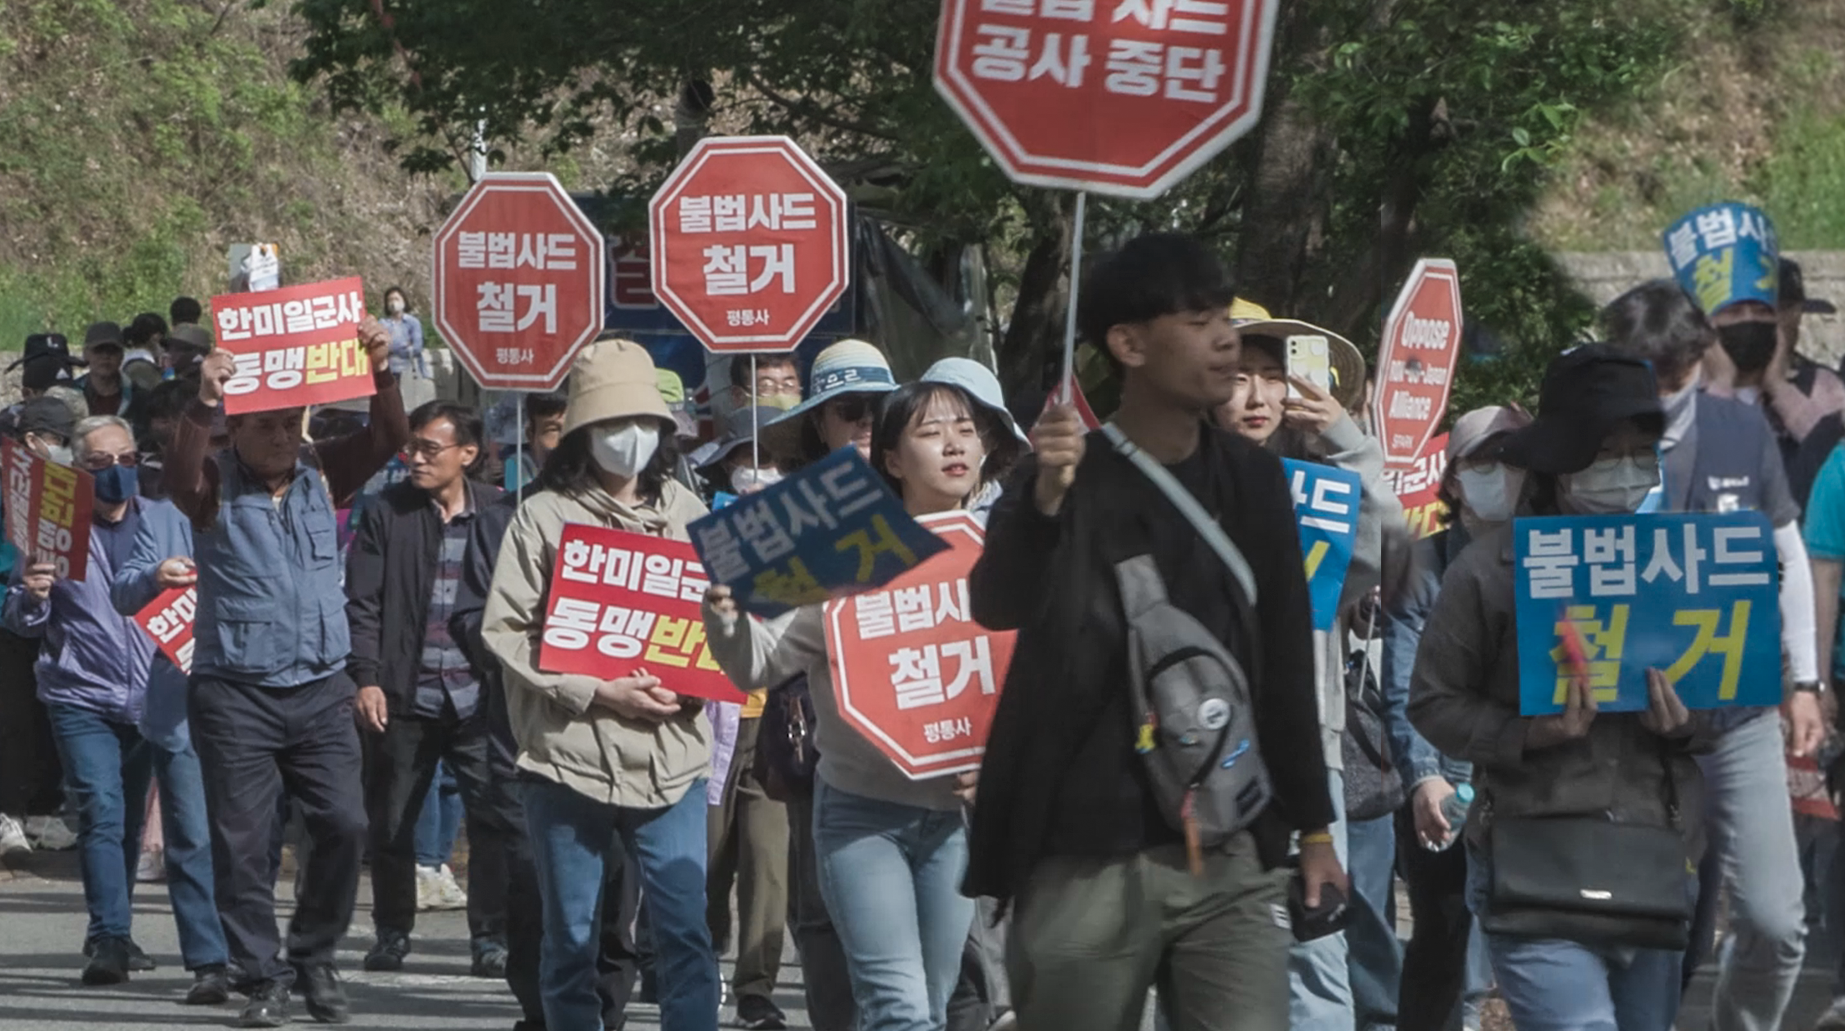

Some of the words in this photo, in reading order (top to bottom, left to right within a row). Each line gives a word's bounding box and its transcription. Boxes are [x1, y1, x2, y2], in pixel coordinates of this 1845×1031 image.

[971, 23, 1092, 88] 공사
[1104, 38, 1226, 103] 중단
[678, 193, 817, 233] 불법사드
[1669, 207, 1778, 270] 불법사
[458, 231, 577, 270] 불법사드
[703, 244, 796, 296] 철거
[217, 291, 362, 341] 한미일군사
[476, 281, 557, 334] 철거
[726, 309, 770, 326] 평통사
[1401, 310, 1450, 350] Oppose
[222, 337, 369, 395] 동맹반대
[698, 460, 885, 584] 불법사드
[1523, 523, 1770, 599] 불법사드
[543, 597, 726, 675] 동맹반
[888, 635, 996, 710] 철거
[923, 716, 972, 743] 평통사
